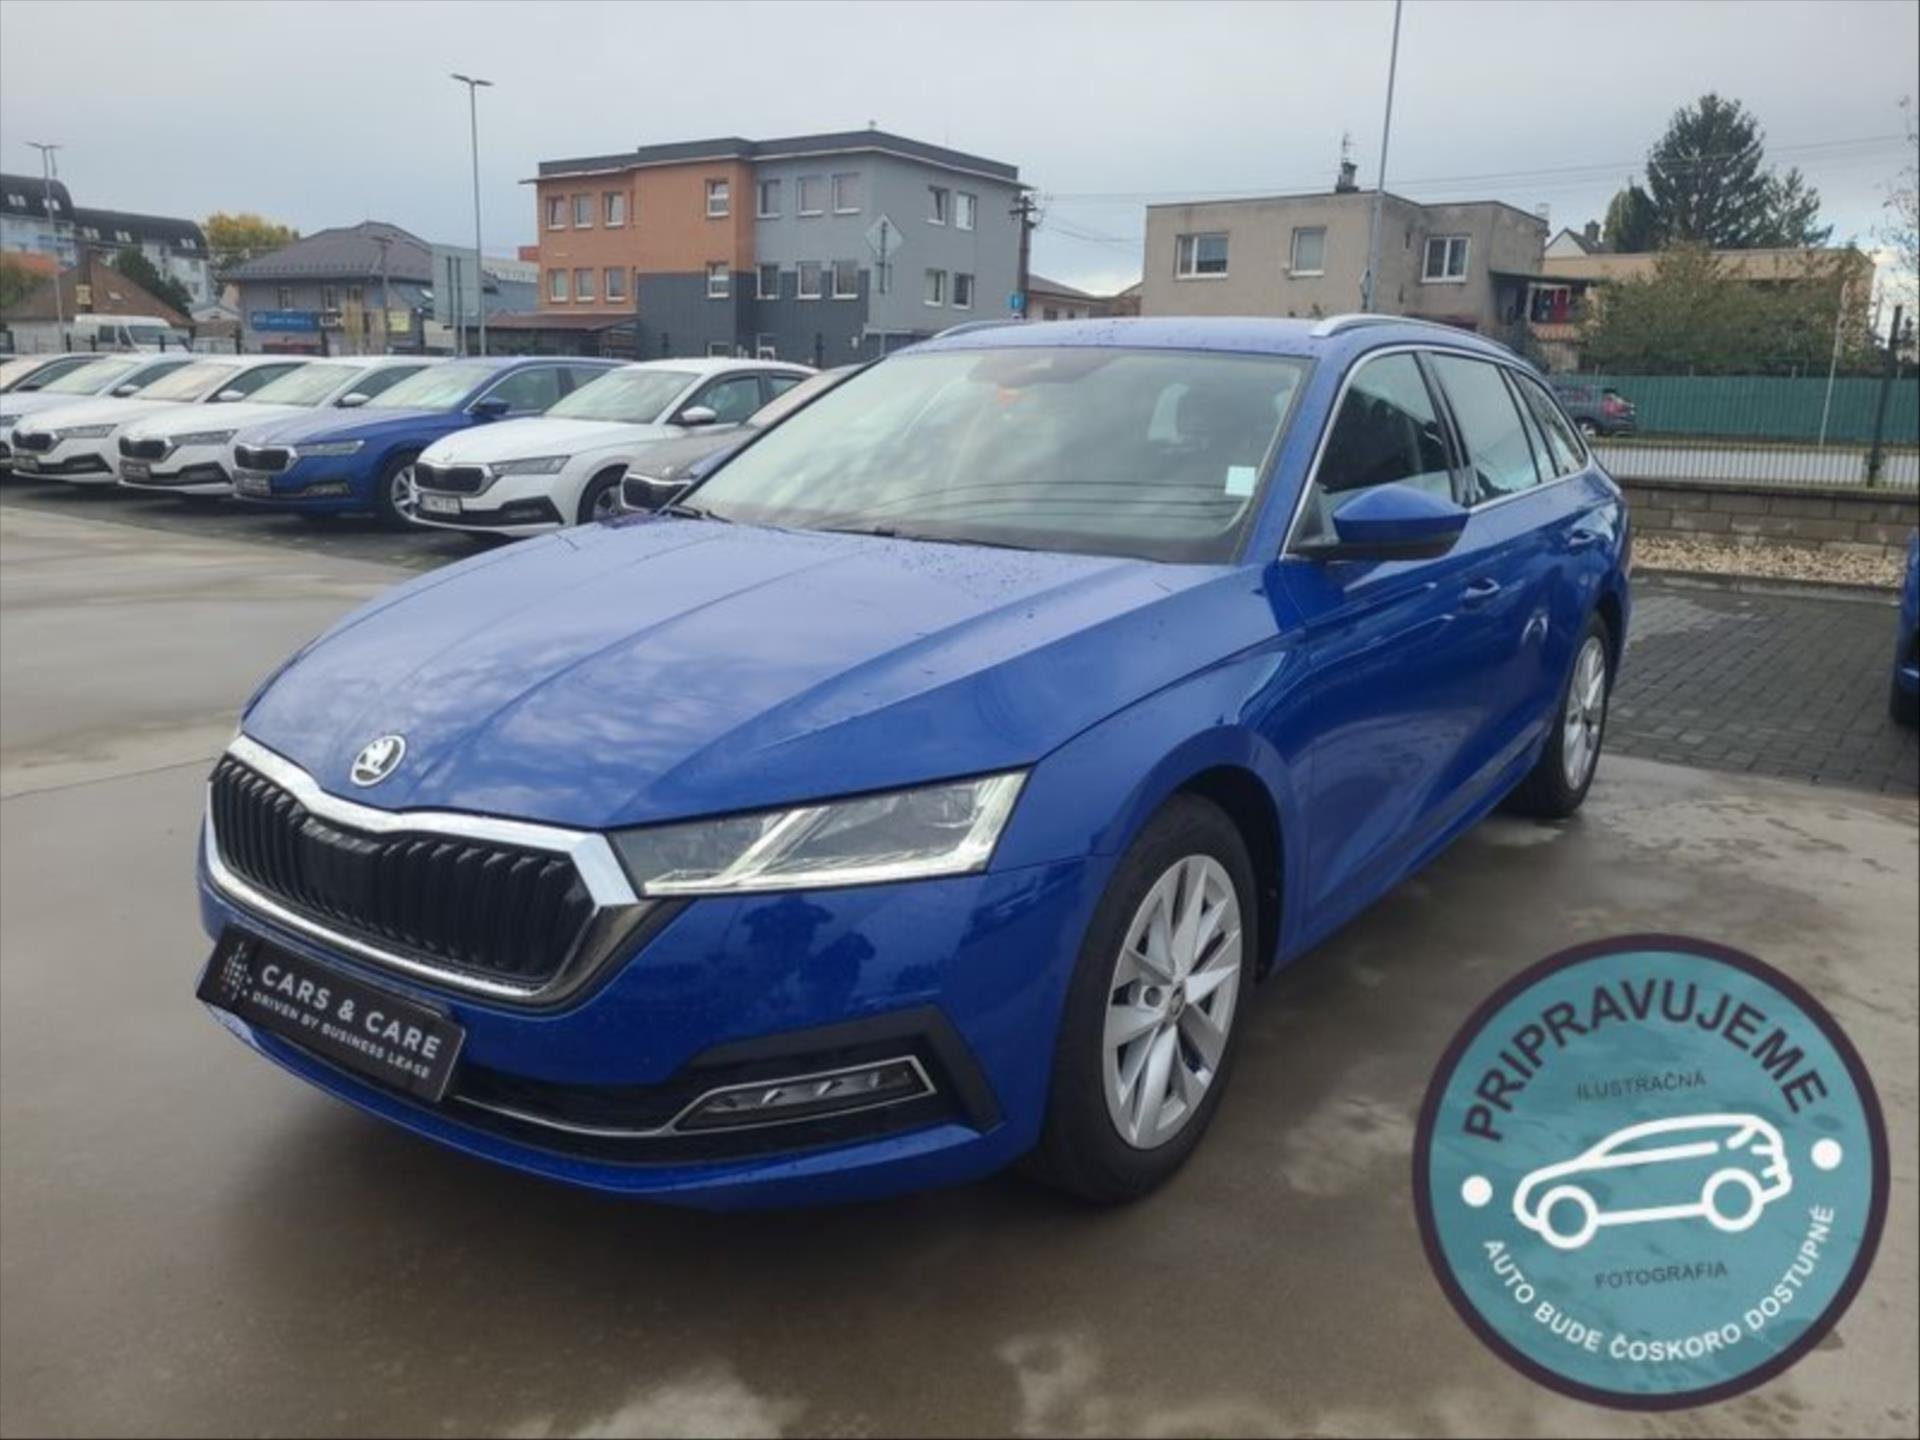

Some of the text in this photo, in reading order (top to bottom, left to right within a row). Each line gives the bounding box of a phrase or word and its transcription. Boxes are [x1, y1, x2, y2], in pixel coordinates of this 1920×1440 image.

[252, 991, 431, 1079] DRIVEN BY BUSINESS LEASE
[262, 965, 441, 1060] CARS & CARE
